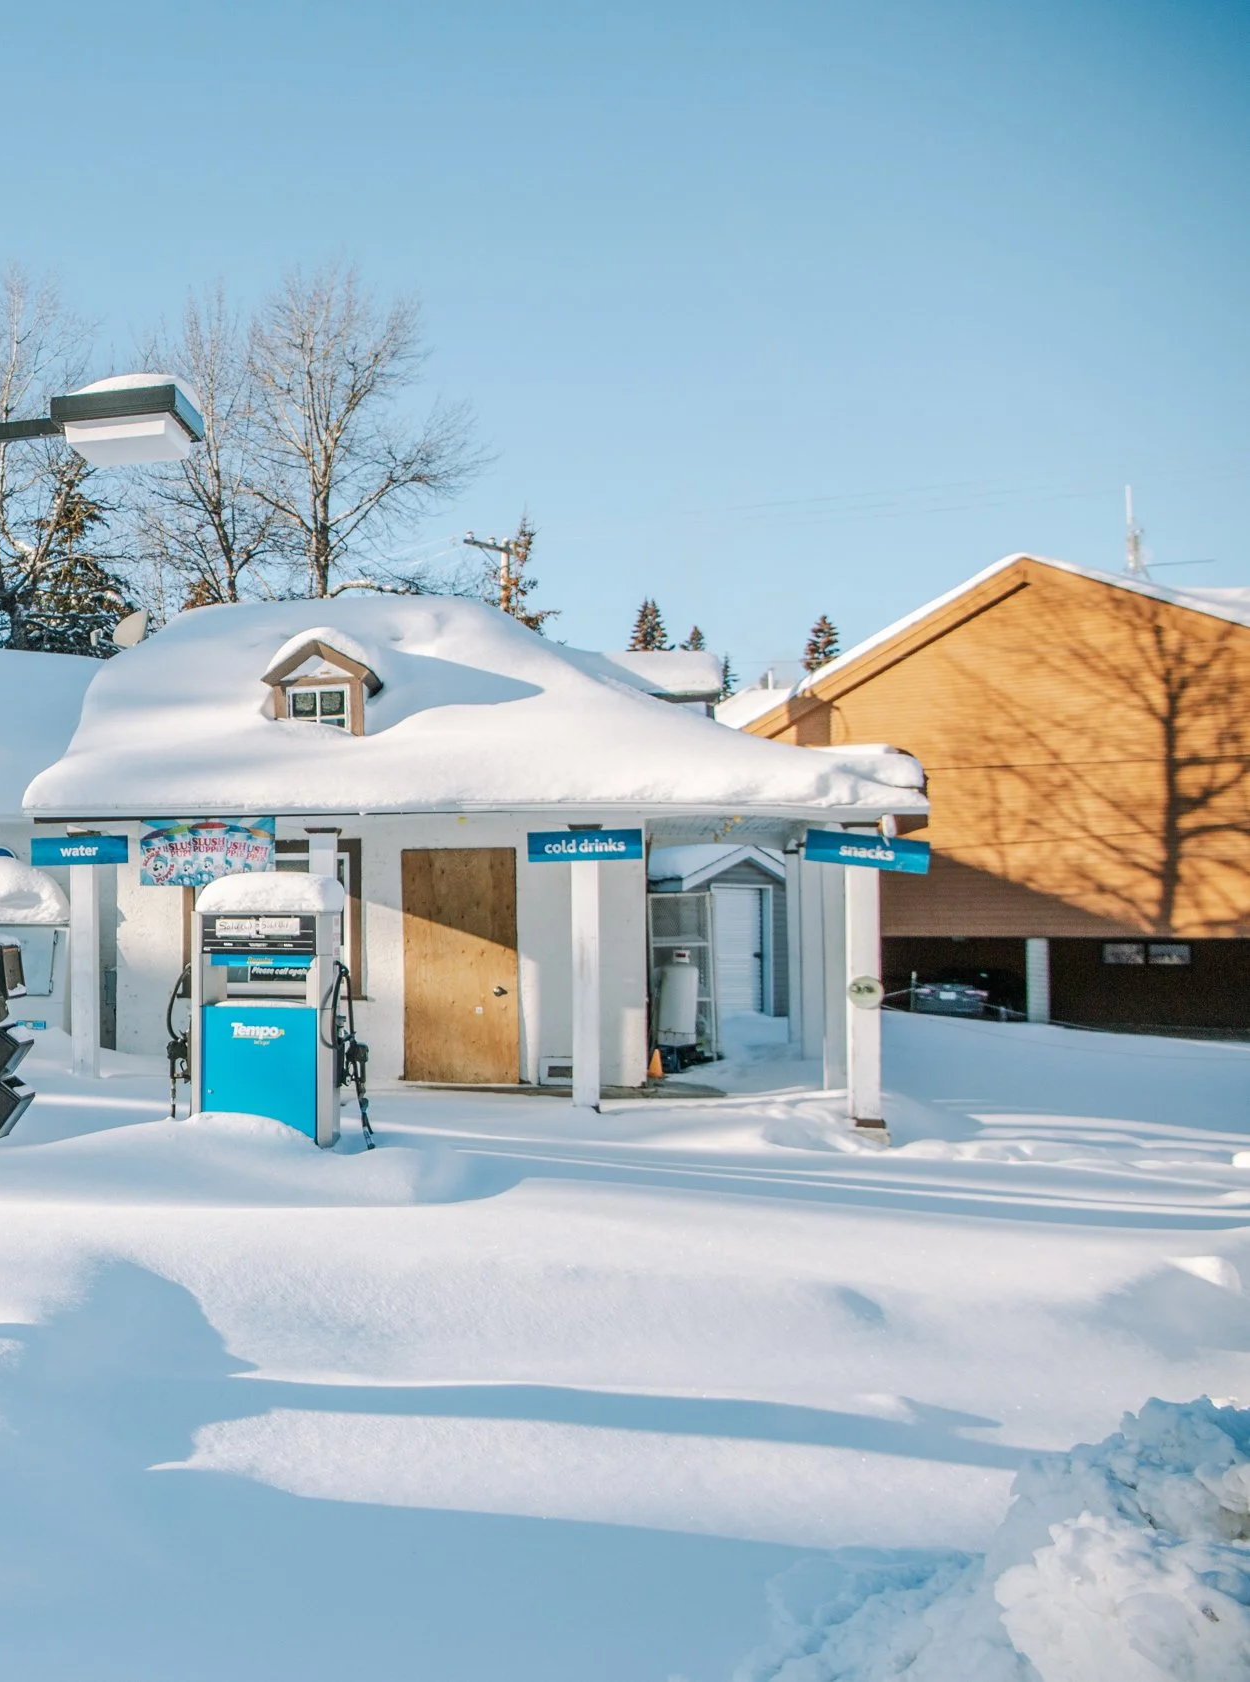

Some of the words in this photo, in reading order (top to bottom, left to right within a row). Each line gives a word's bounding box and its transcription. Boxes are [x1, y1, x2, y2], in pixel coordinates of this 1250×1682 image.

[192, 836, 225, 847] SLUSH
[544, 839, 577, 854] cold
[578, 838, 627, 853] drinks
[59, 845, 99, 857] water
[193, 845, 224, 853] PUPPIE
[838, 845, 896, 861] snacks
[251, 966, 274, 975] Please
[274, 967, 290, 975] call
[231, 1022, 279, 1040] Tempo
